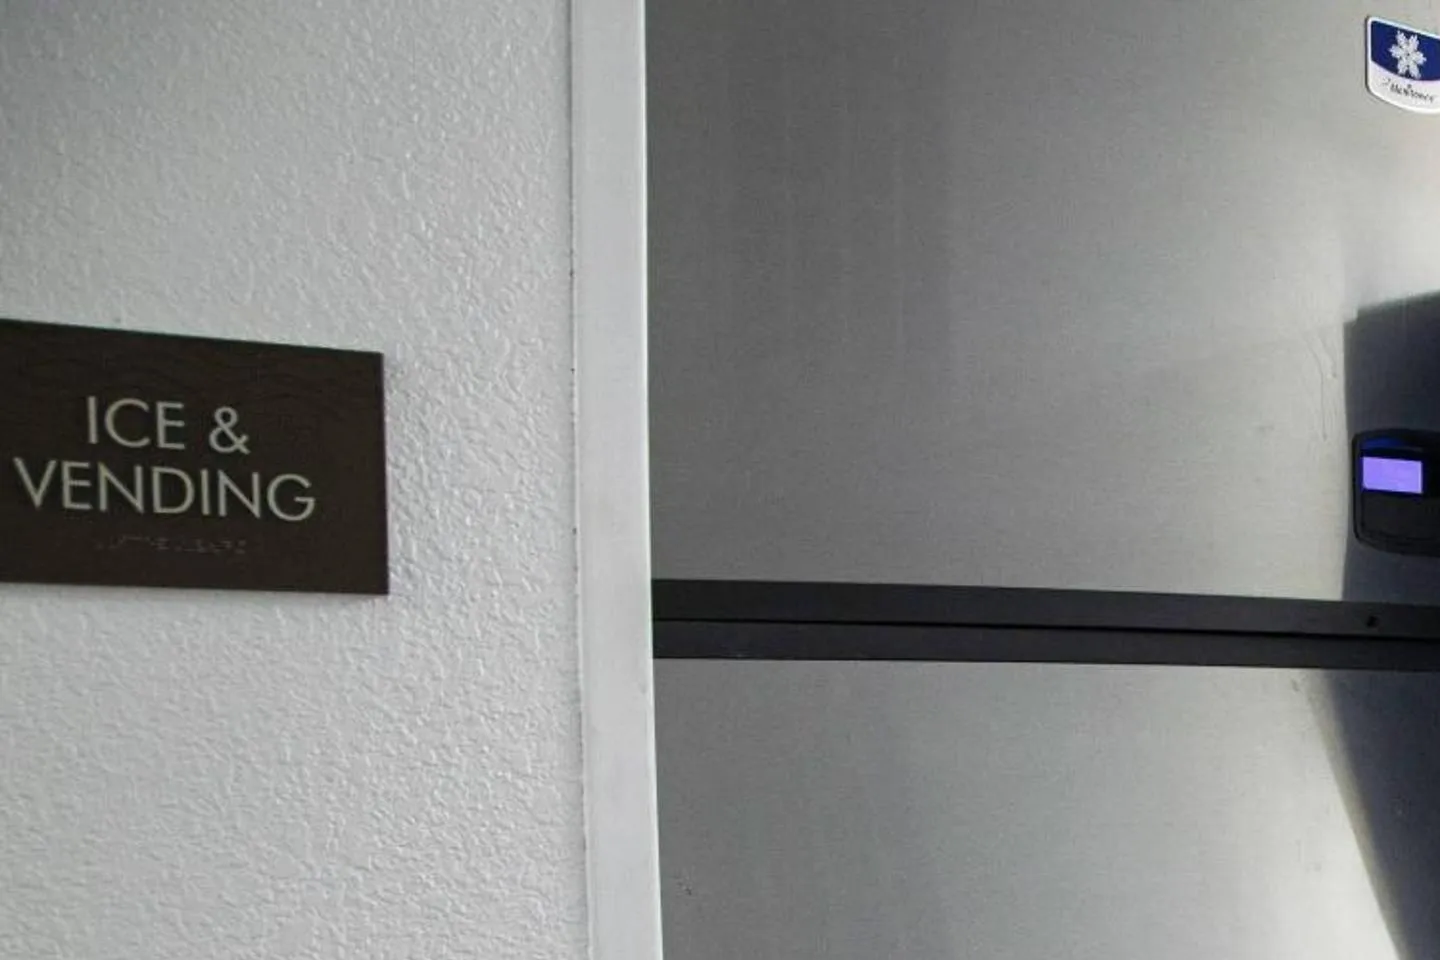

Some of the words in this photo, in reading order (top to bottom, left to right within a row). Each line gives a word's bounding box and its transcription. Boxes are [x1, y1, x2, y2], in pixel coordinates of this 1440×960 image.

[87, 396, 186, 450] ICE
[208, 406, 251, 455] &
[13, 456, 316, 522] VENDING
